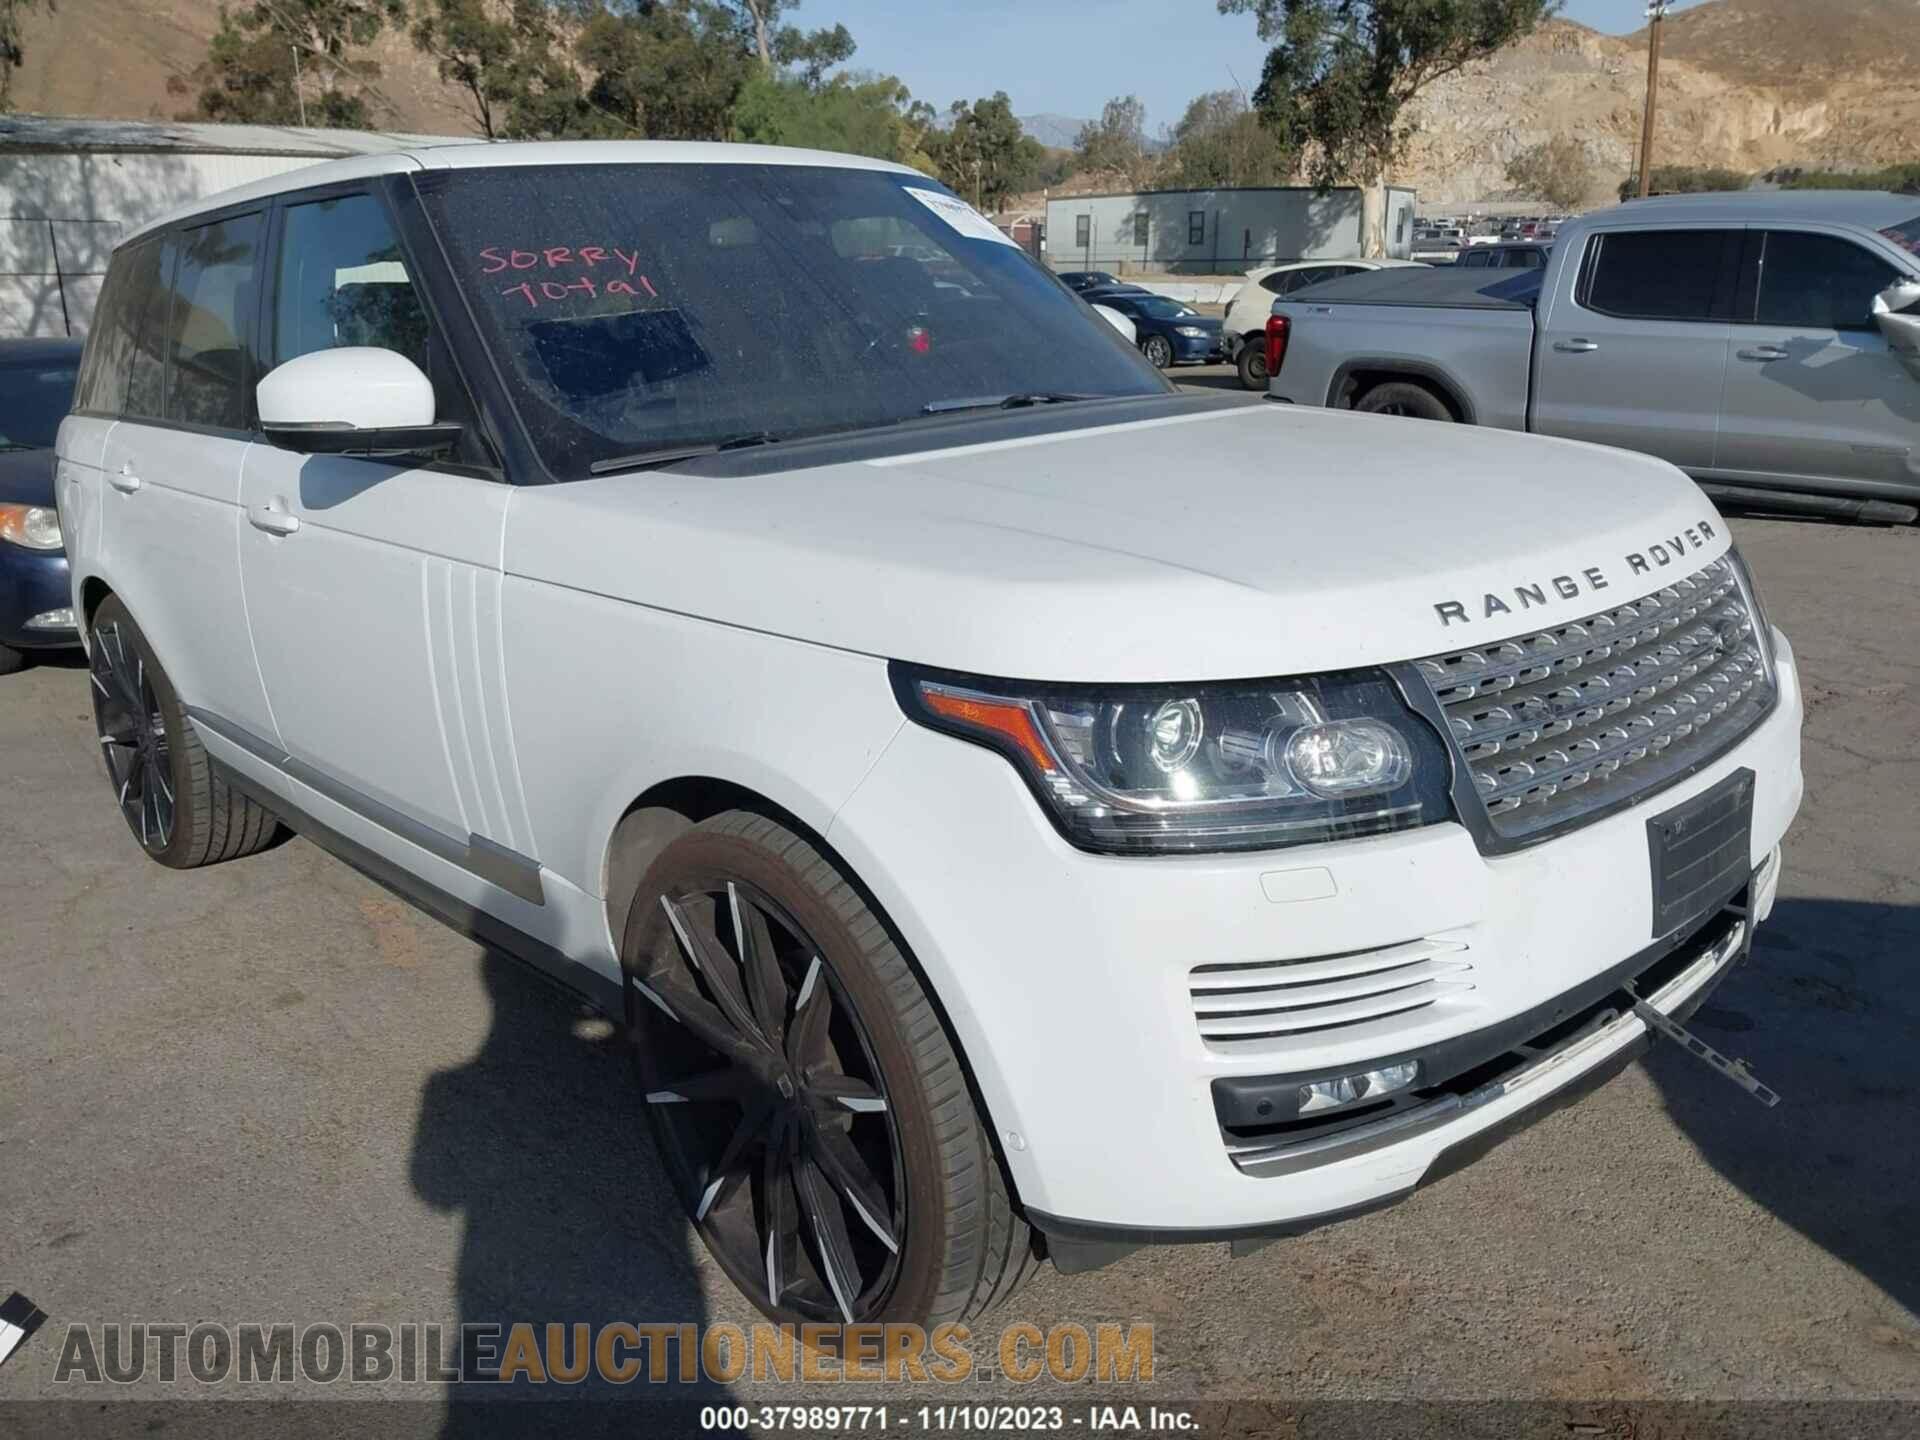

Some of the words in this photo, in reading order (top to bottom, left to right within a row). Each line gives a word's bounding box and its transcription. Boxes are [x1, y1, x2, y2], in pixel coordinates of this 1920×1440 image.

[480, 247, 638, 275] SORRY
[1434, 567, 1608, 626] RANGE
[1625, 520, 1716, 575] ROVER
